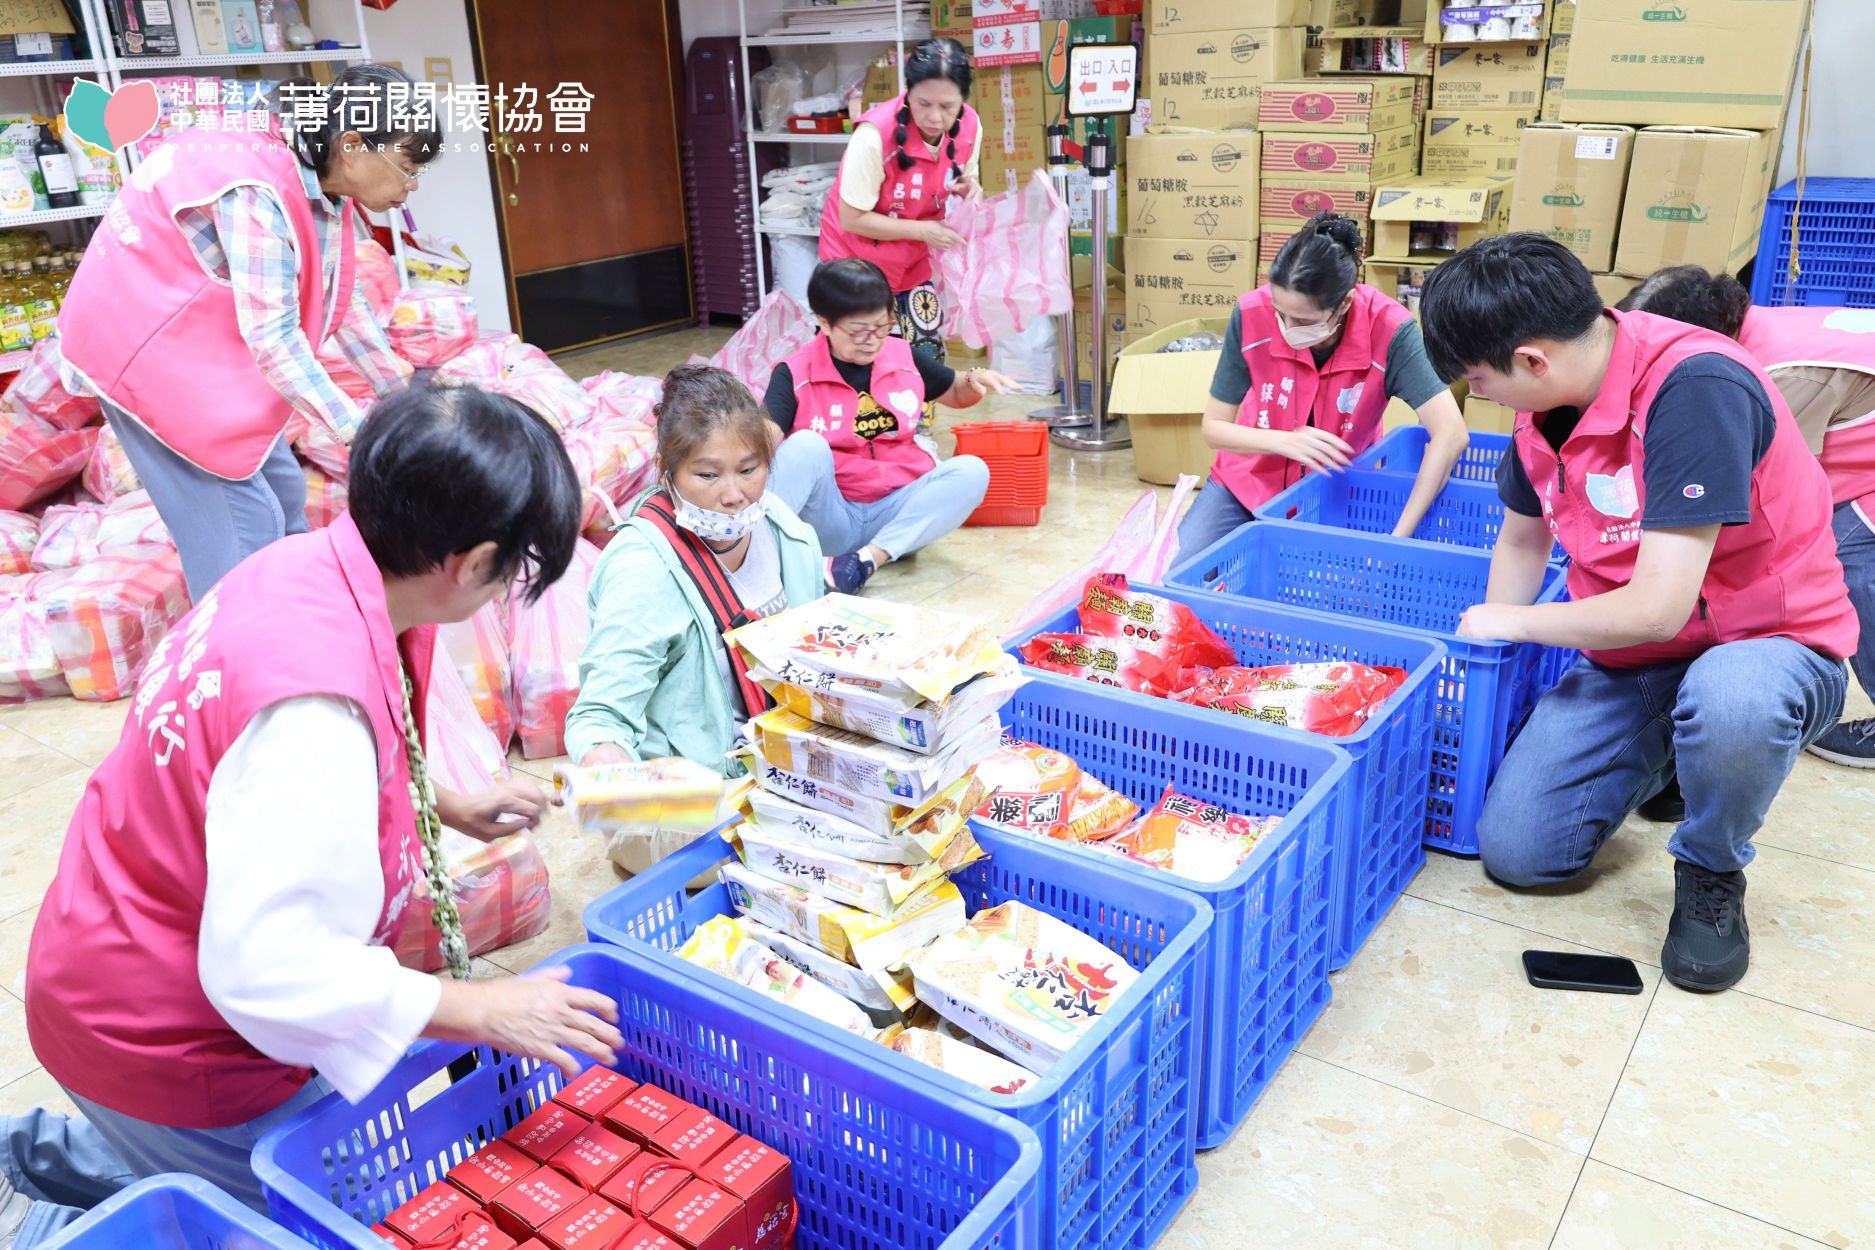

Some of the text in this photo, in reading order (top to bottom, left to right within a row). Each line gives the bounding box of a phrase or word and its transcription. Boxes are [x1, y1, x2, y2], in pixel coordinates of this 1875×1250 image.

[1164, 6, 1182, 22] 12
[1080, 59, 1132, 76] 出口 入口
[1610, 54, 1705, 65] 吃得健康 生活充滿生機
[1158, 70, 1208, 87] 葡萄糖胺
[1163, 96, 1181, 120] 12
[1137, 178, 1188, 193] 葡萄糖胺
[1133, 274, 1185, 291] 葡萄糖胺
[778, 660, 836, 691] 杏仁餅
[766, 766, 817, 800] 杏仁餅
[772, 852, 828, 886] 杏仁餅
